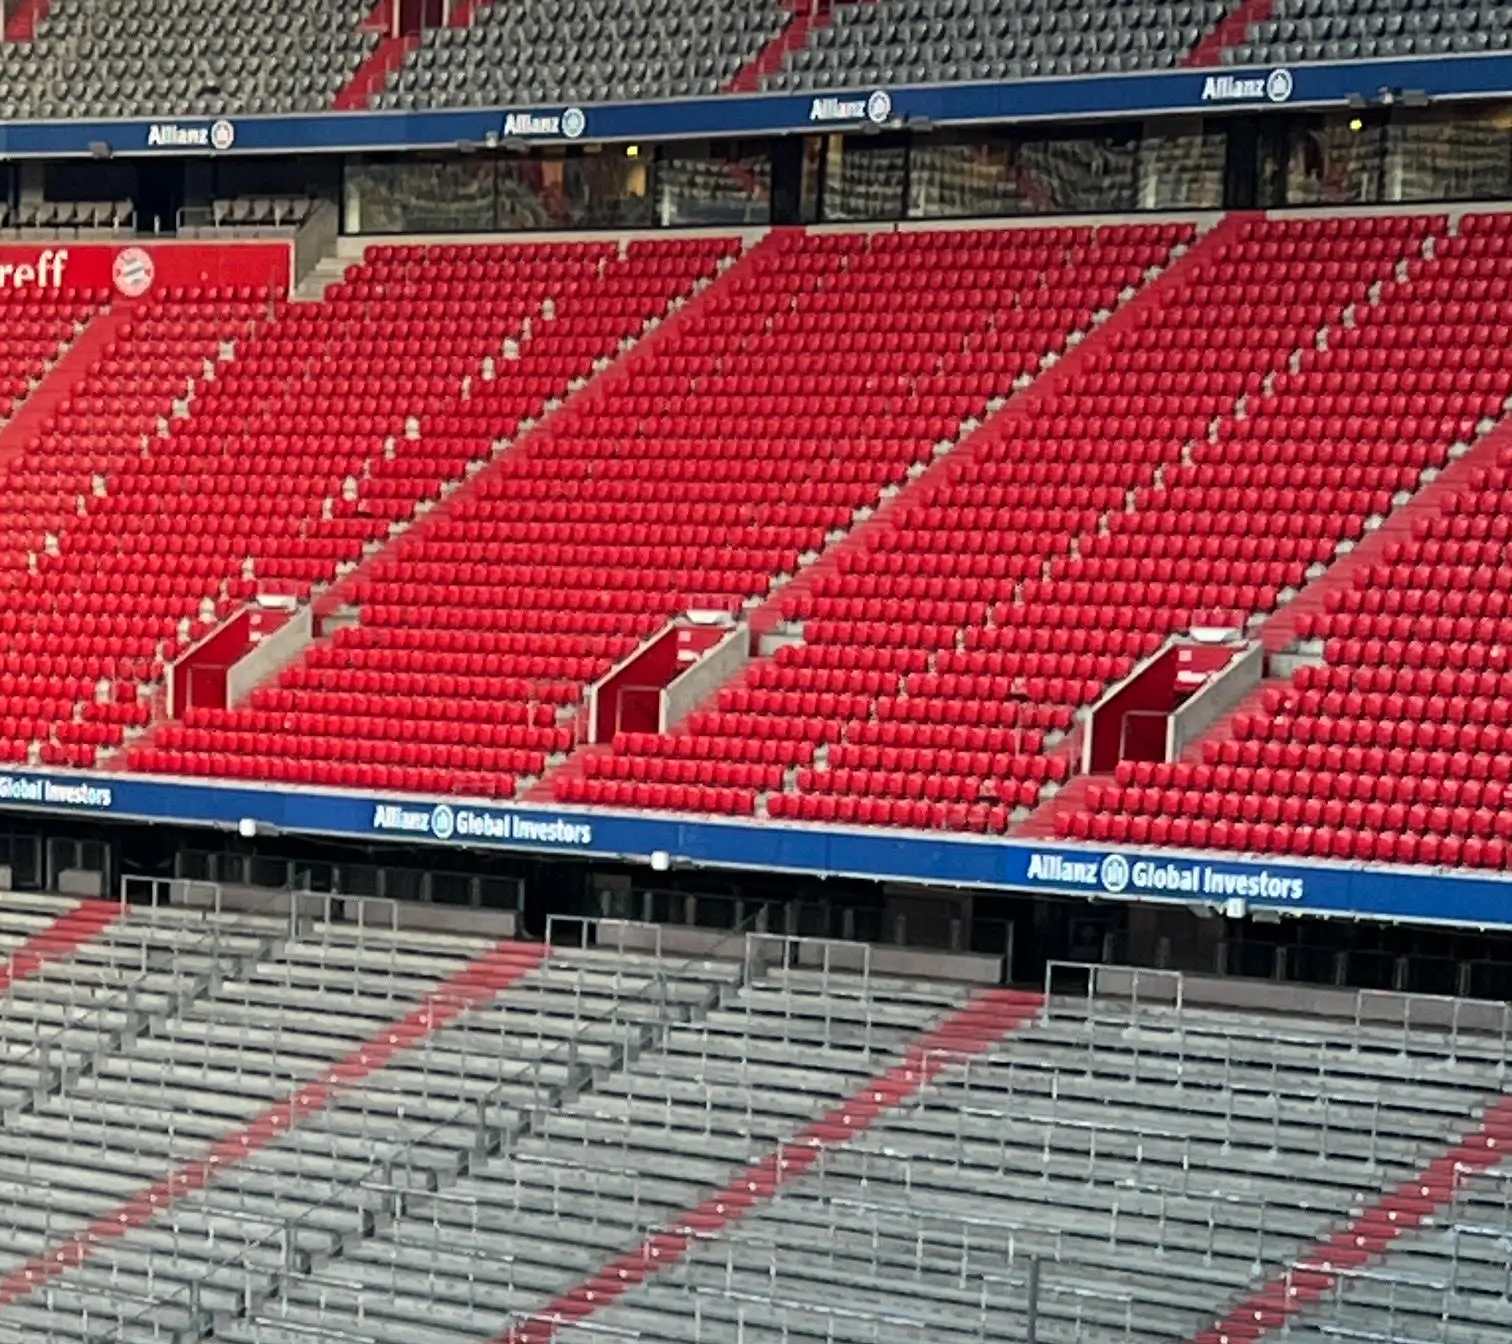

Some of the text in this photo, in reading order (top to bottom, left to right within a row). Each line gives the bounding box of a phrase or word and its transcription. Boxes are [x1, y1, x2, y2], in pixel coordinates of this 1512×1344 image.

[1202, 77, 1265, 99] Allianz
[809, 98, 866, 122] Allianz
[148, 124, 208, 146] Allianz
[504, 114, 559, 136] Allianz
[45, 780, 111, 806] Investors
[374, 805, 591, 844] Allianz Global Investors
[1027, 854, 1303, 899] Allianz Global Investors
